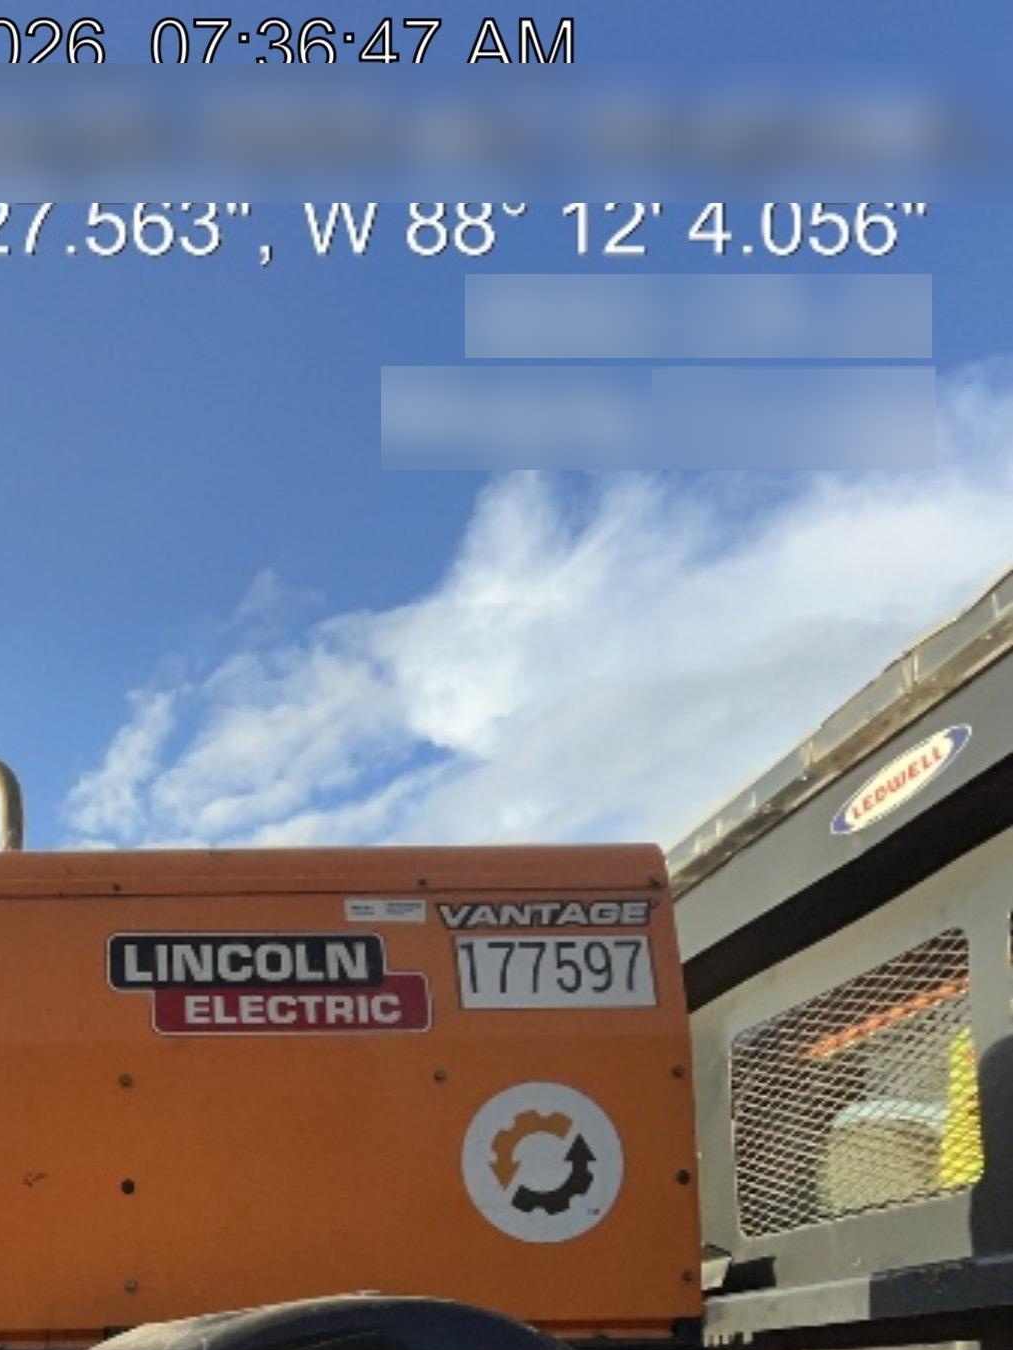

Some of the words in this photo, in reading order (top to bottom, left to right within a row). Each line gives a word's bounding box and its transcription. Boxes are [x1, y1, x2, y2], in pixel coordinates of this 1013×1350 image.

[852, 746, 944, 820] LEDWELL
[438, 901, 650, 929] VANTAGE
[123, 942, 371, 983] LINCOLN
[459, 940, 642, 995] 177597
[184, 994, 403, 1025] ELECTRIC
